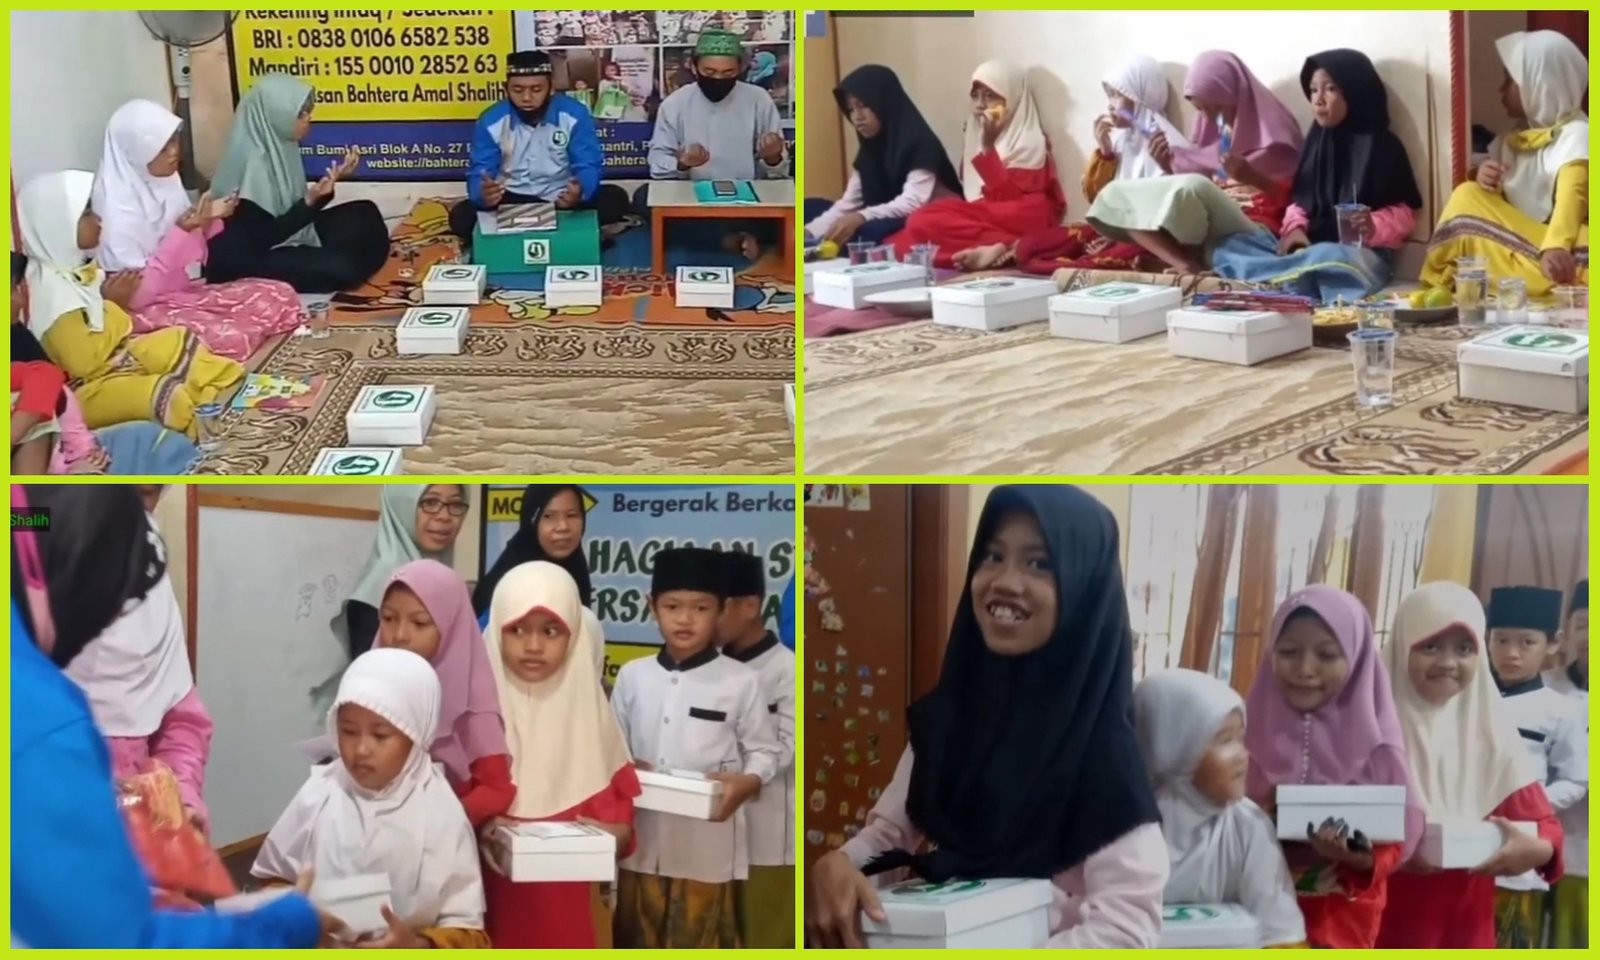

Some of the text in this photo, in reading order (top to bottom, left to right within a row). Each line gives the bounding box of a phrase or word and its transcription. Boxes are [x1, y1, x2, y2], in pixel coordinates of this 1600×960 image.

[253, 29, 283, 48] BRI
[298, 28, 346, 48] 0838
[351, 27, 396, 47] 0106
[400, 26, 449, 47] 6582
[454, 25, 490, 46] 538
[249, 56, 320, 77] Mandiri
[334, 56, 365, 76] 155
[369, 55, 415, 75] 0010
[420, 54, 469, 75] 2852
[474, 53, 498, 74] 63
[347, 83, 408, 103] Bahtera
[412, 81, 452, 102] Amal
[457, 80, 505, 101] Shalih
[380, 143, 408, 154] Blok
[411, 143, 421, 153] A
[424, 143, 445, 154] No.
[448, 142, 463, 153] 27
[613, 492, 718, 517] Bergerak
